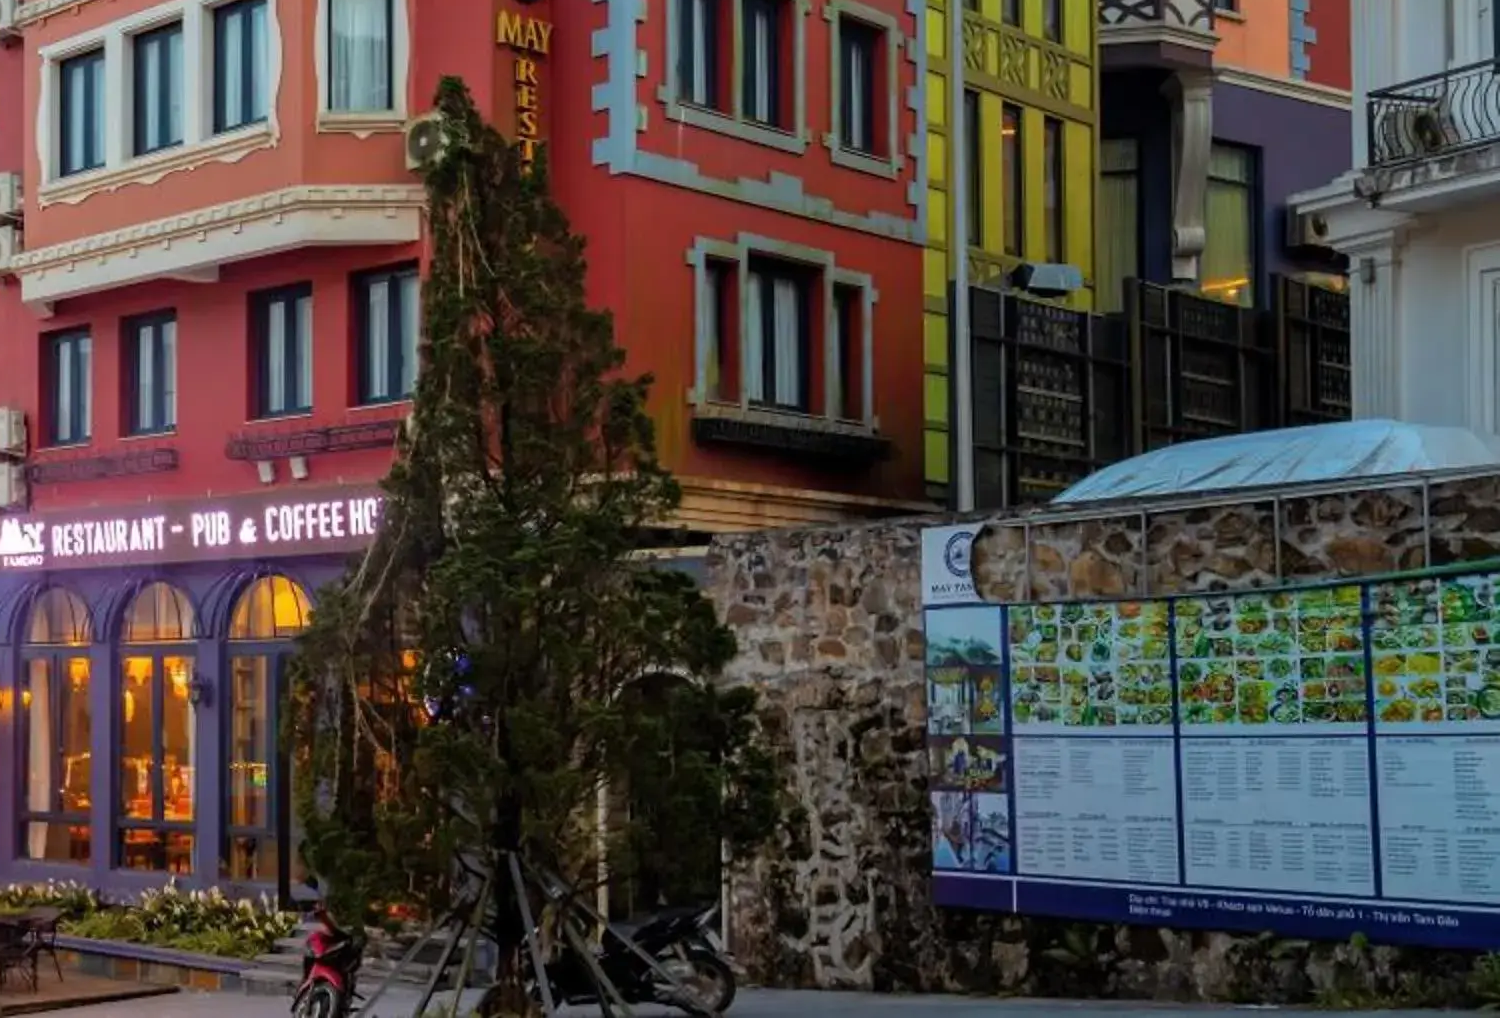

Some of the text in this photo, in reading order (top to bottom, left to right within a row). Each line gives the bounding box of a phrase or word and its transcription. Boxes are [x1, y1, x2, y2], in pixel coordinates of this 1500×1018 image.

[496, 9, 553, 54] MAY
[514, 58, 540, 175] REST
[52, 515, 166, 556] RESTAURANT
[191, 510, 231, 547] PUB
[239, 517, 257, 544] &
[265, 501, 345, 542] COFFEE
[349, 497, 382, 535] HO
